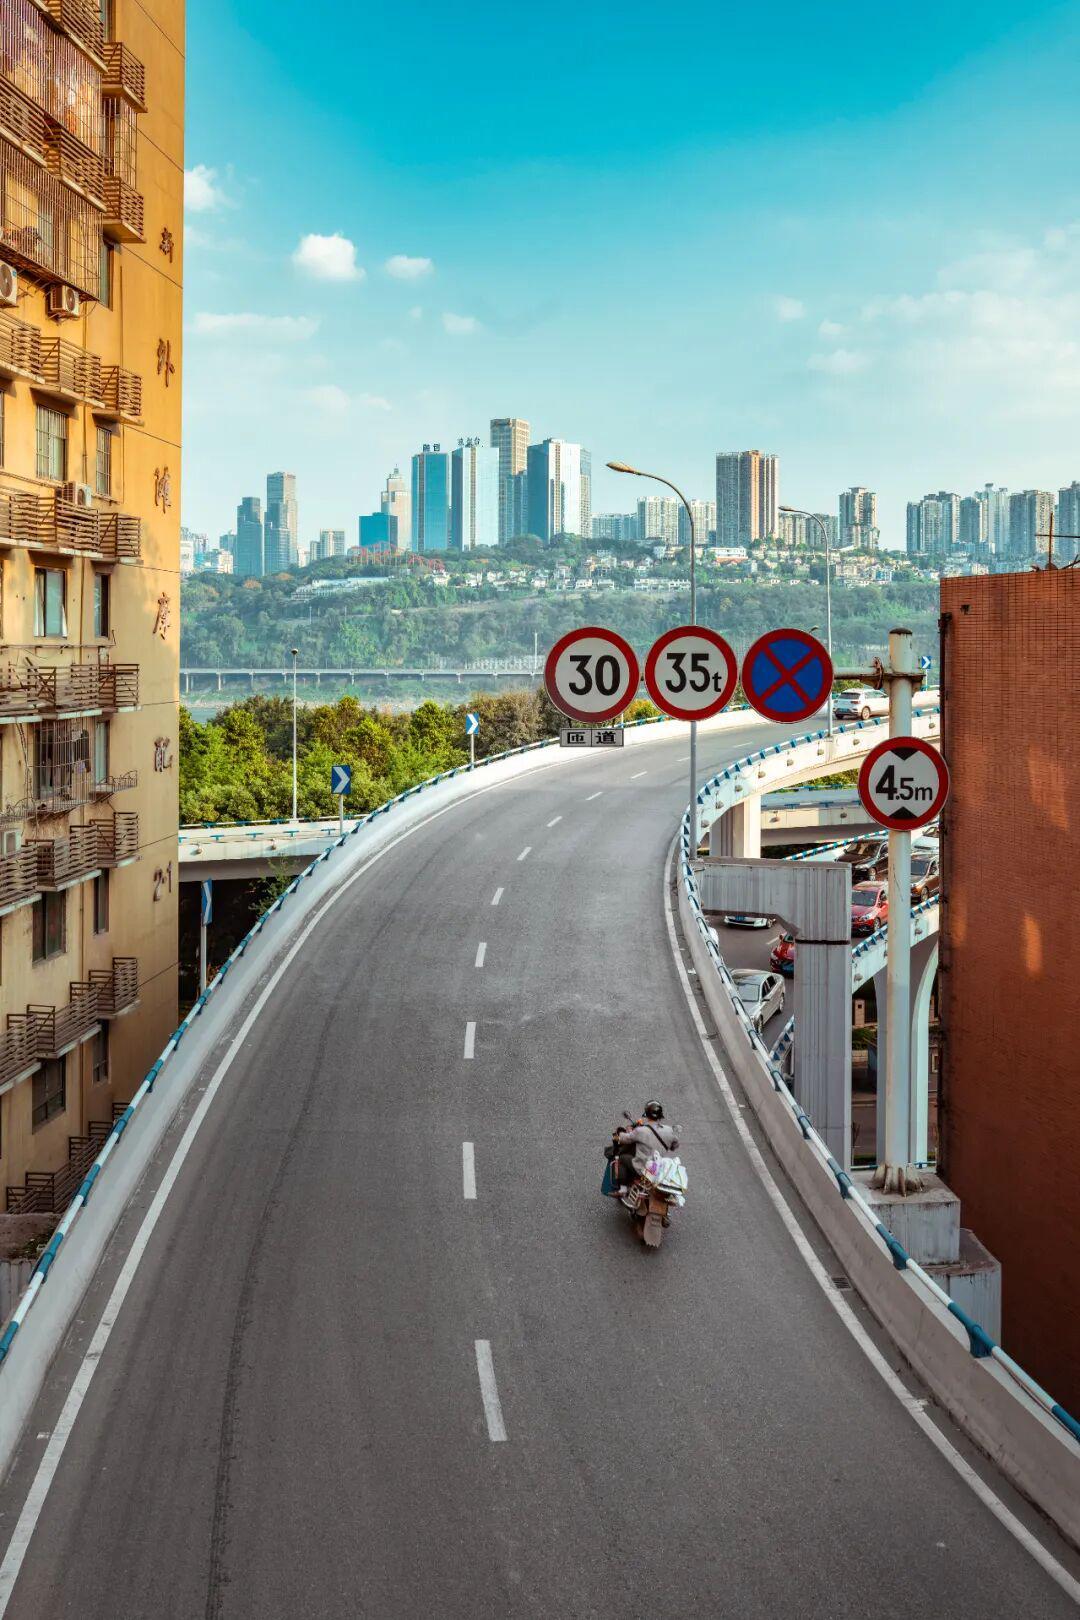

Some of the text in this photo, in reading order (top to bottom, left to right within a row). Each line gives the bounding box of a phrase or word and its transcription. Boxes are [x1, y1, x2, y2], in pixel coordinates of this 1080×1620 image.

[568, 654, 621, 696] 30
[665, 652, 723, 694] 35t
[567, 731, 616, 744] 匝道
[875, 764, 933, 802] 4.5m
